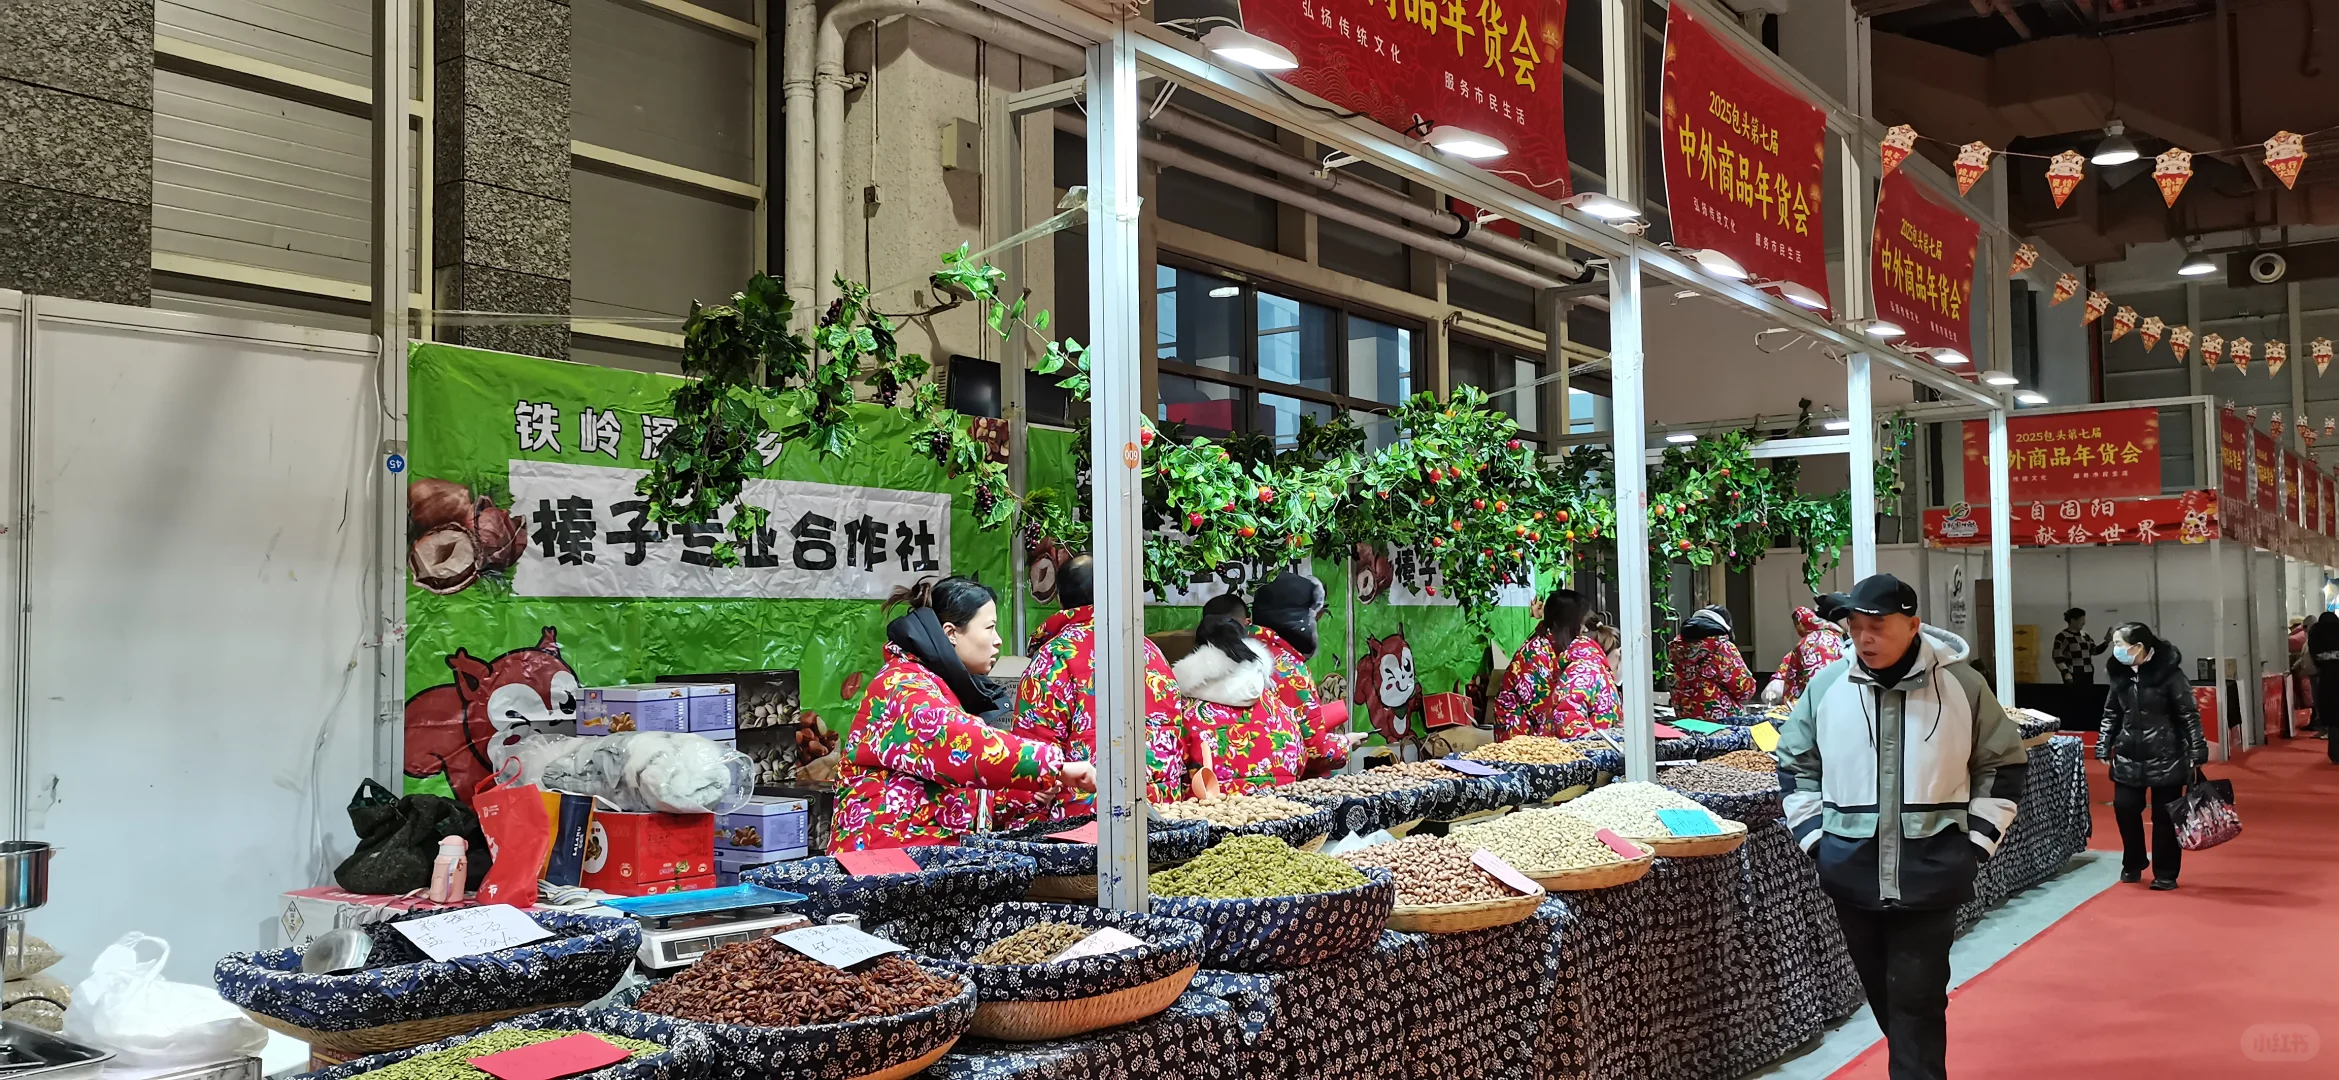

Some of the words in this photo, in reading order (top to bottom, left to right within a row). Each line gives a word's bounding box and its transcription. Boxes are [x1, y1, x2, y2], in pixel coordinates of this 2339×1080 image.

[1302, 2, 1402, 64] 弘扬传统文化
[1444, 71, 1526, 125] 服务市民生活
[1709, 90, 1779, 157] 2025包头第七届
[1678, 112, 1811, 237] 中外商品年货会
[1693, 196, 1737, 234] 弘扬传统文化
[1881, 238, 1962, 321] 中外商品年货会
[2015, 427, 2103, 443] 2025包头第七届
[532, 496, 940, 573] 榛子专业合作社
[2034, 519, 2162, 546] 献给世界
